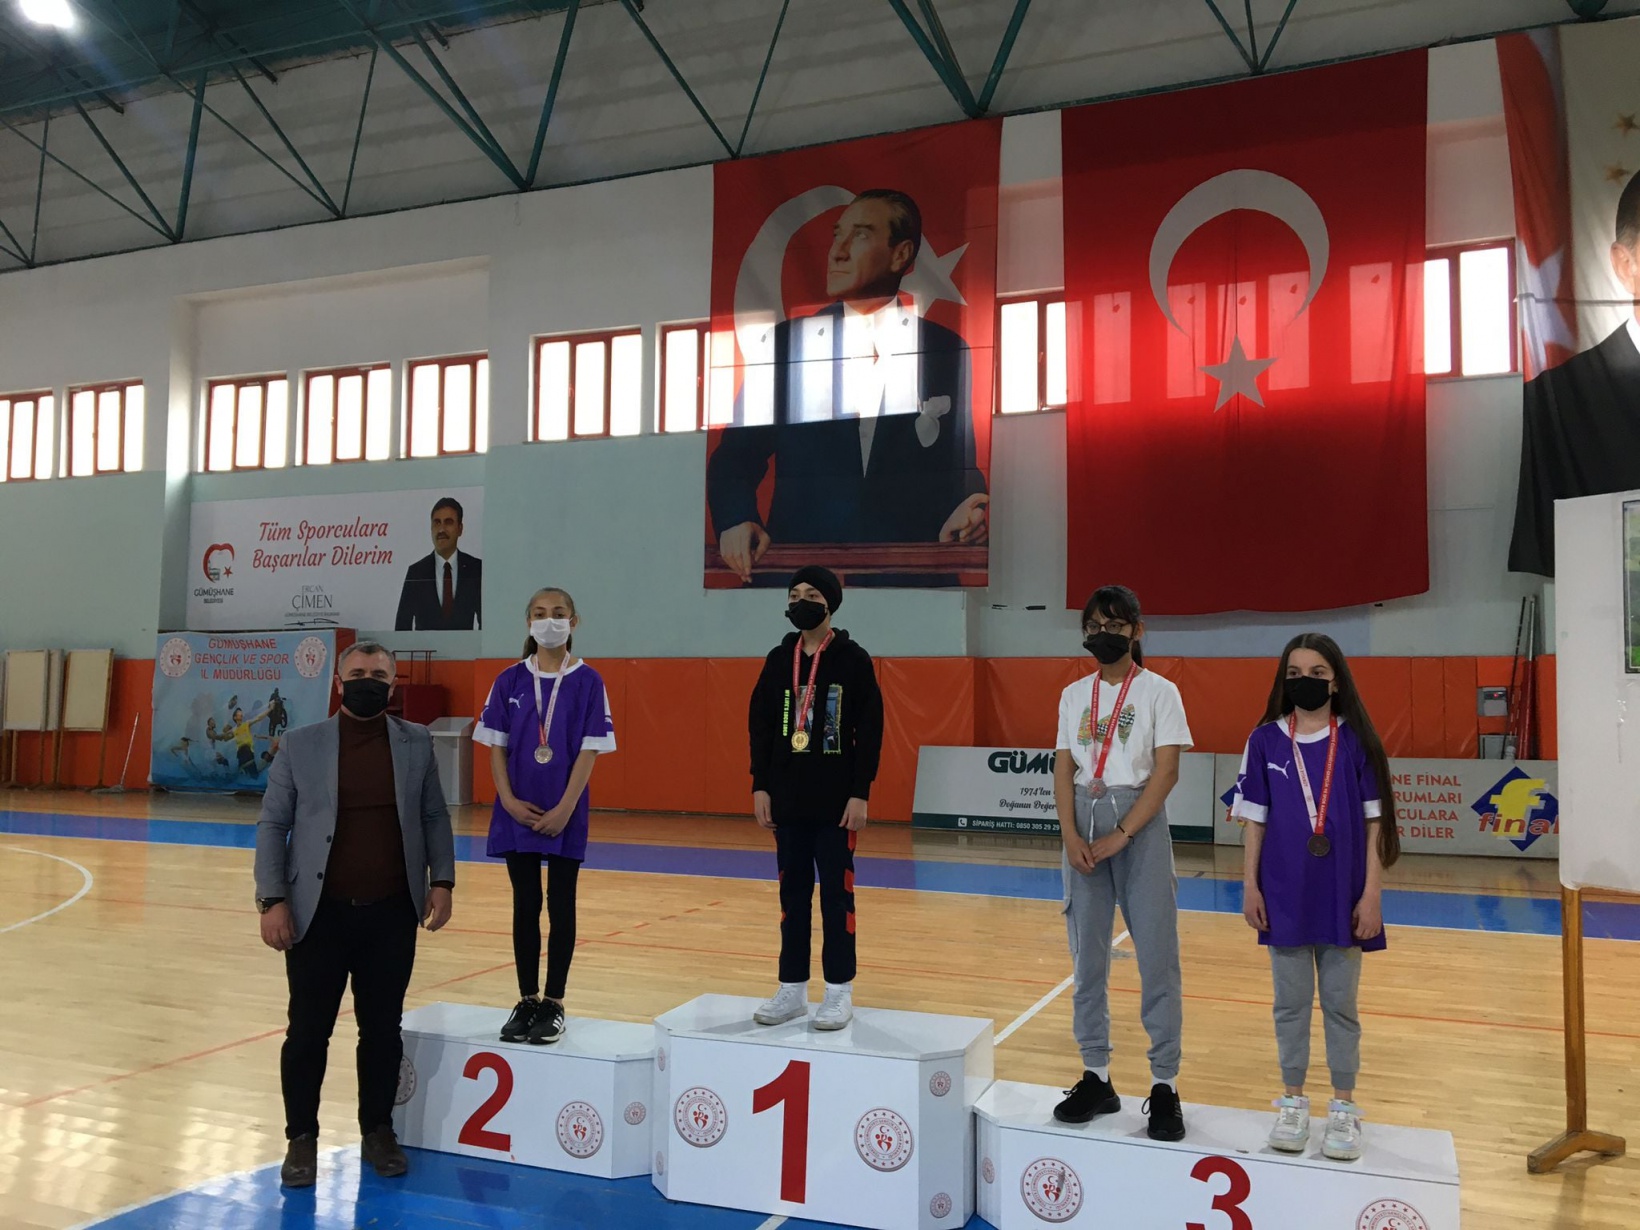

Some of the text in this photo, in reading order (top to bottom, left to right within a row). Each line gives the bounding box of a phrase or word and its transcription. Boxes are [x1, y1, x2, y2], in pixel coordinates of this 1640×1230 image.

[259, 516, 389, 546] Tüm Sporculara
[252, 543, 393, 573] Başarılar Dilerim
[193, 587, 234, 598] GÜMÜŞHANE
[242, 653, 257, 665] VE
[259, 652, 290, 665] SPOR
[1416, 771, 1461, 787] FİNAL
[972, 820, 995, 829] SİPARİŞ
[1016, 822, 1031, 830] 0850
[1410, 823, 1455, 839] DİLER
[457, 1051, 514, 1153] 2
[752, 1059, 810, 1205] 1
[1185, 1155, 1253, 1230] 3
